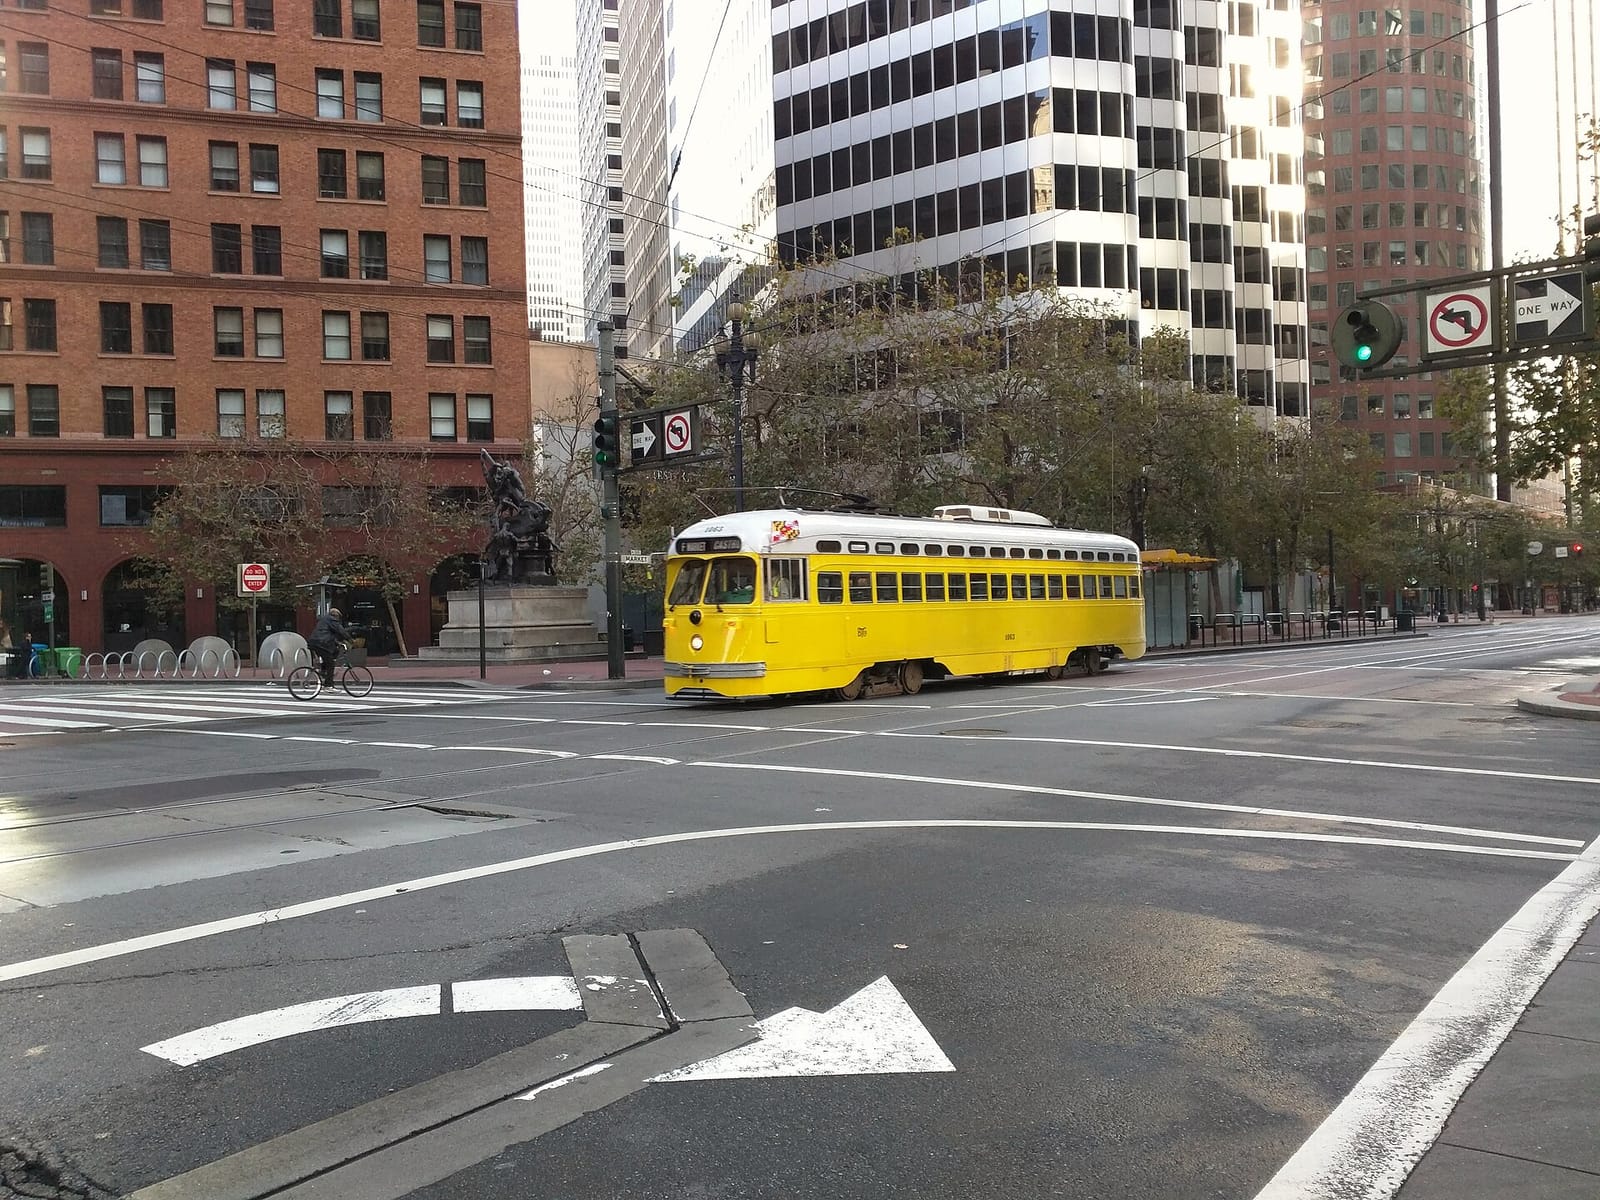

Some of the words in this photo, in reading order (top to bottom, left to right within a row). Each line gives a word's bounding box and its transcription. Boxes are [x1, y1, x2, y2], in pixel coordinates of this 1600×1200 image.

[1518, 304, 1542, 316] ONE
[1550, 299, 1575, 312] WAY
[633, 437, 643, 445] ONE
